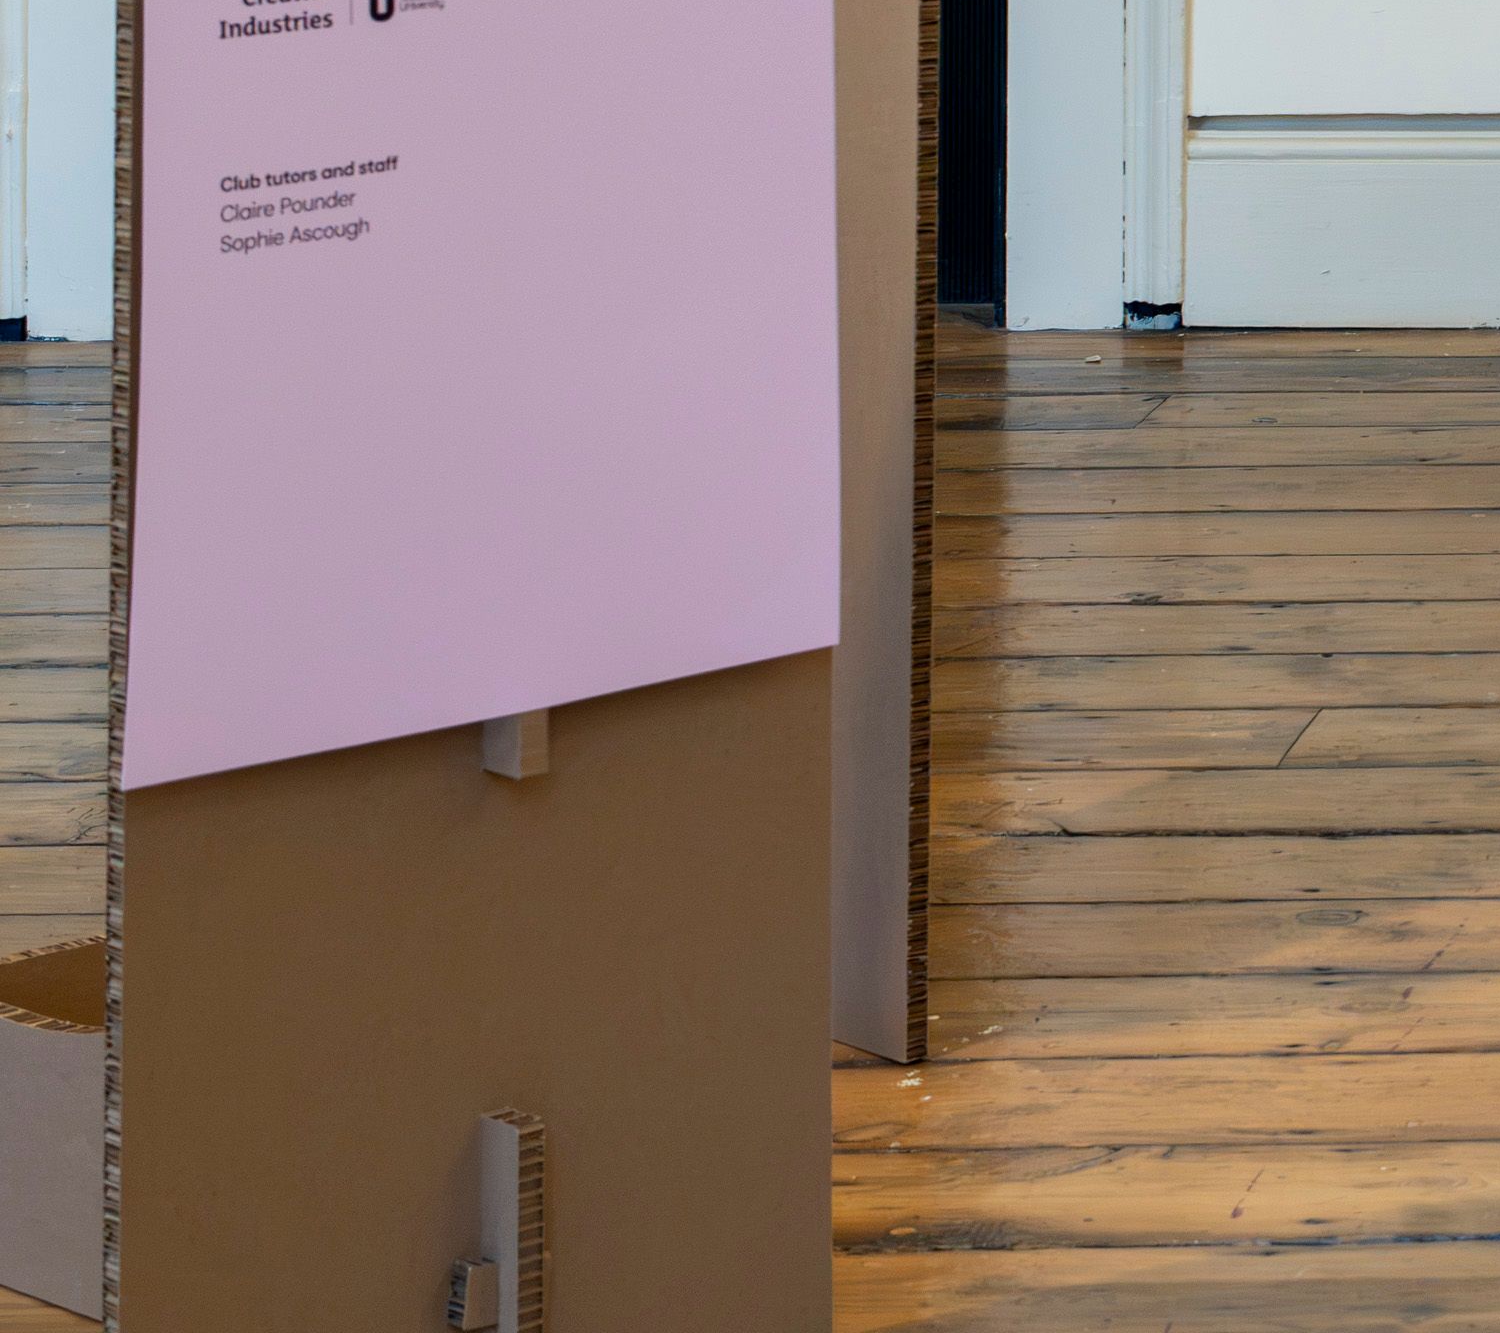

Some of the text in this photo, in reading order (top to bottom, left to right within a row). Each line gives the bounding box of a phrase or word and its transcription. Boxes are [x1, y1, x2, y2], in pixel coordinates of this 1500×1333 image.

[219, 11, 334, 40] Industries
[220, 155, 399, 193] Club tutors and staff
[219, 190, 357, 223] Claire Pounder
[220, 217, 370, 255] Sophie Ascough
